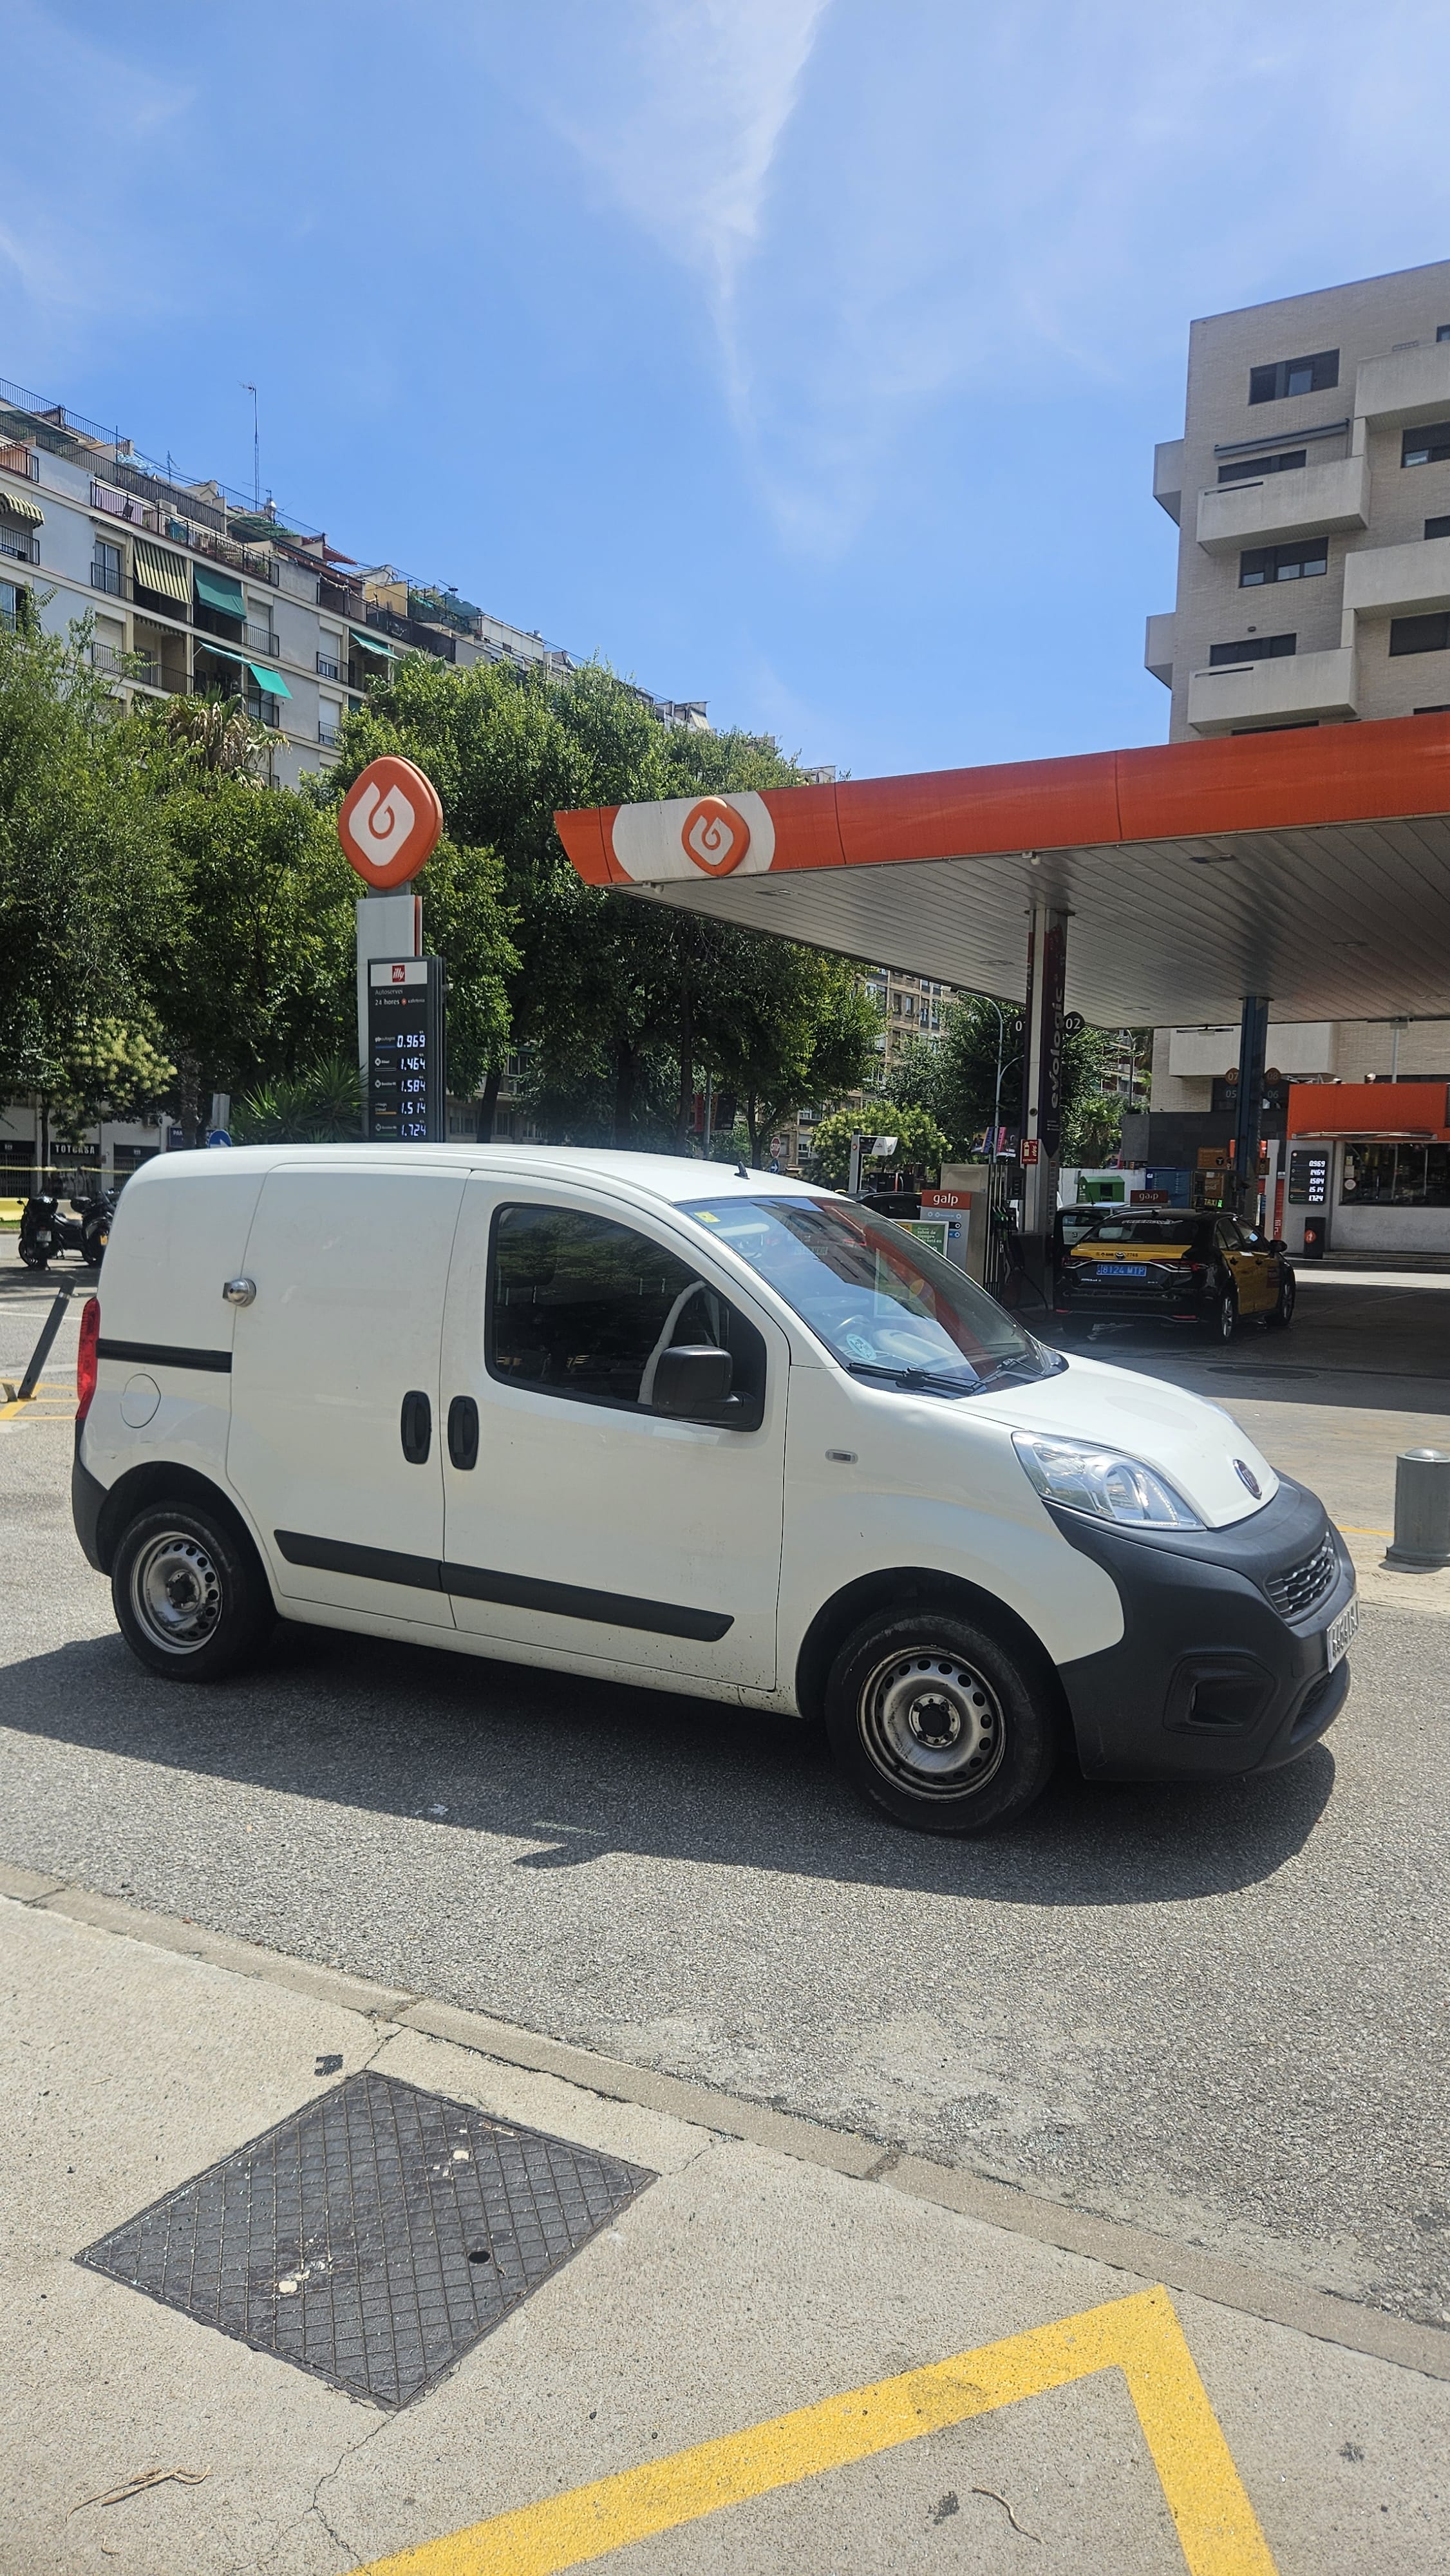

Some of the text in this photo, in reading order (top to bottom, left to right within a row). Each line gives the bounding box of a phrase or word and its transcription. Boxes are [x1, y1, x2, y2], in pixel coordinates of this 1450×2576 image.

[393, 968, 404, 981] illy
[1015, 1020, 1026, 1032] 0
[1066, 1018, 1081, 1030] 02
[397, 1034, 426, 1048] 0.969
[1049, 986, 1063, 1109] evologic
[400, 1057, 426, 1070] 1.464
[1227, 1072, 1239, 1081] 07
[400, 1079, 426, 1092] 1.584
[1225, 1090, 1237, 1098] 05
[1267, 1090, 1279, 1099] 06
[401, 1101, 426, 1114] 1.514
[401, 1123, 426, 1137] 1.724
[933, 1193, 959, 1206] galp
[1102, 1265, 1124, 1274] 8124
